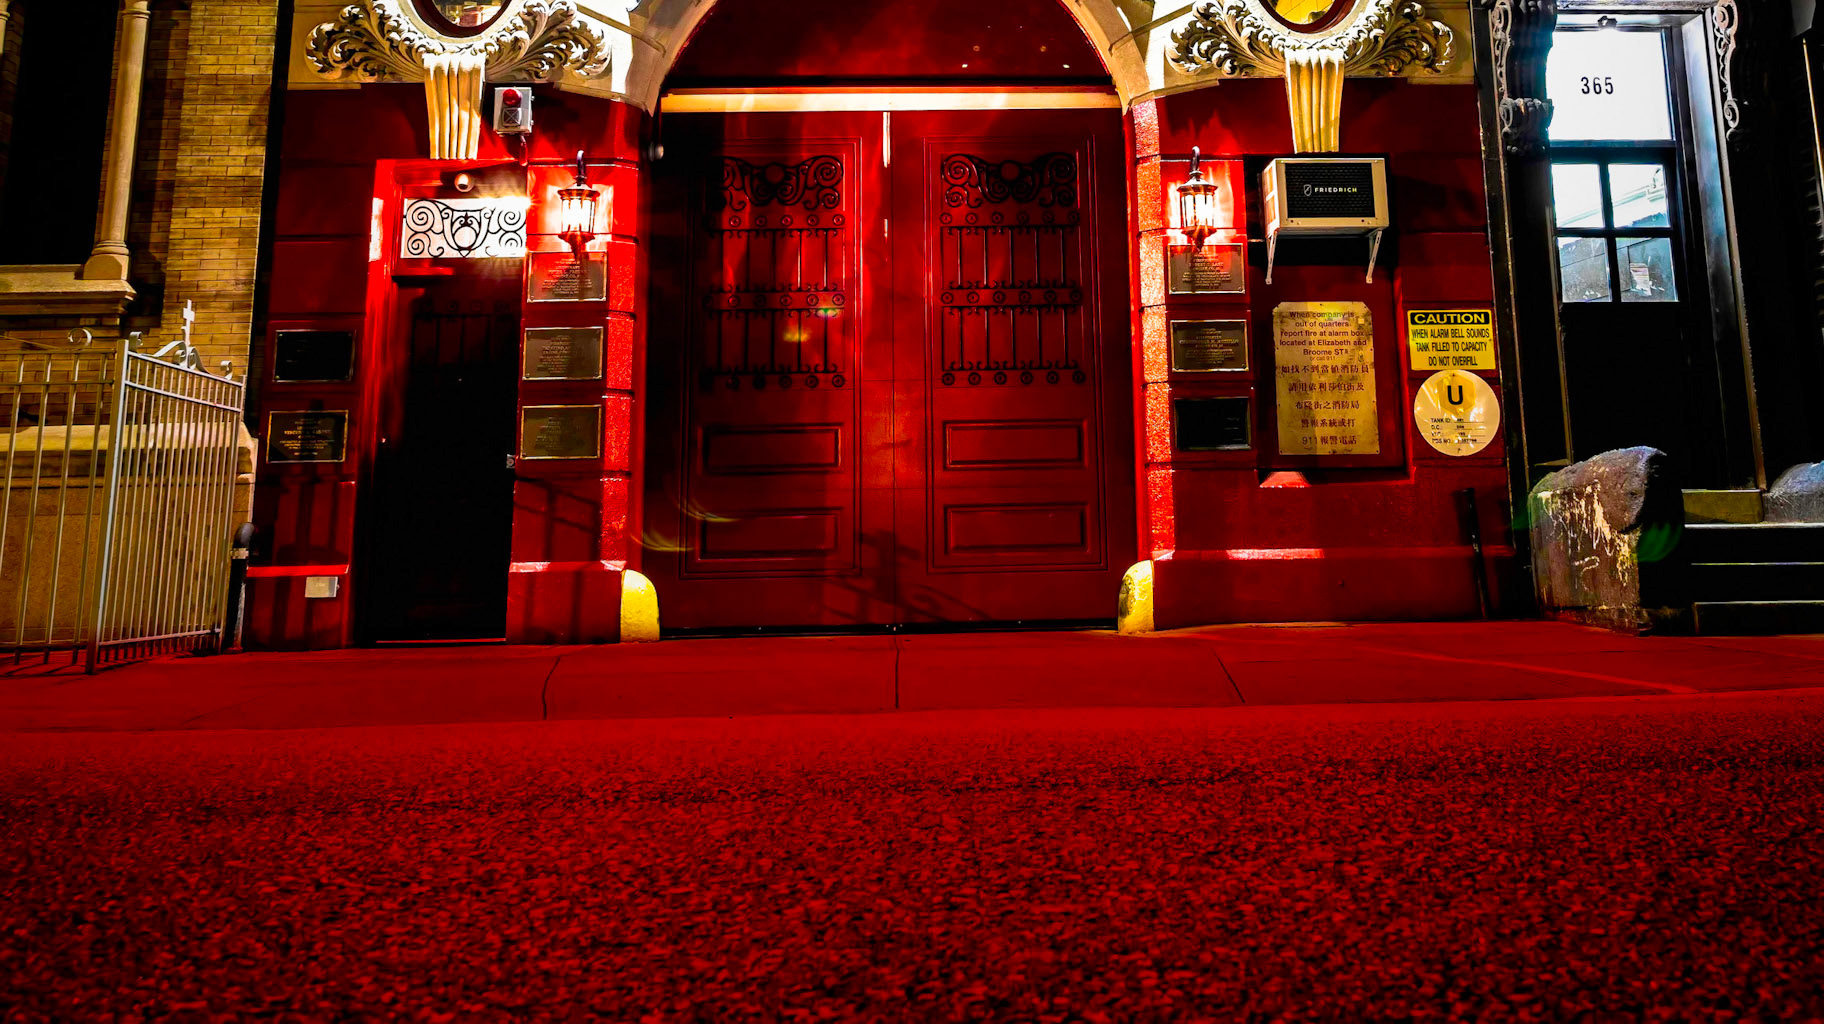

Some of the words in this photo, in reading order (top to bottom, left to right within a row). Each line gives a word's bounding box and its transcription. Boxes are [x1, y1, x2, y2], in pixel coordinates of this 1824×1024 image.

[1580, 76, 1614, 95] 365
[1414, 313, 1485, 324] CAUTION
[1412, 329, 1428, 338] WHEN
[1430, 329, 1449, 338] ALARM
[1451, 329, 1465, 338] BELL
[1466, 328, 1490, 338] SOUNDS
[1416, 342, 1430, 352] TANK
[1431, 342, 1450, 351] FILLED
[1452, 342, 1459, 351] TO
[1461, 342, 1487, 352] CAPACITY
[1428, 356, 1437, 366] DO
[1439, 356, 1450, 366] NOT
[1452, 356, 1478, 366] OVERFILL
[1447, 385, 1464, 405] U
[1302, 436, 1318, 445] 911
